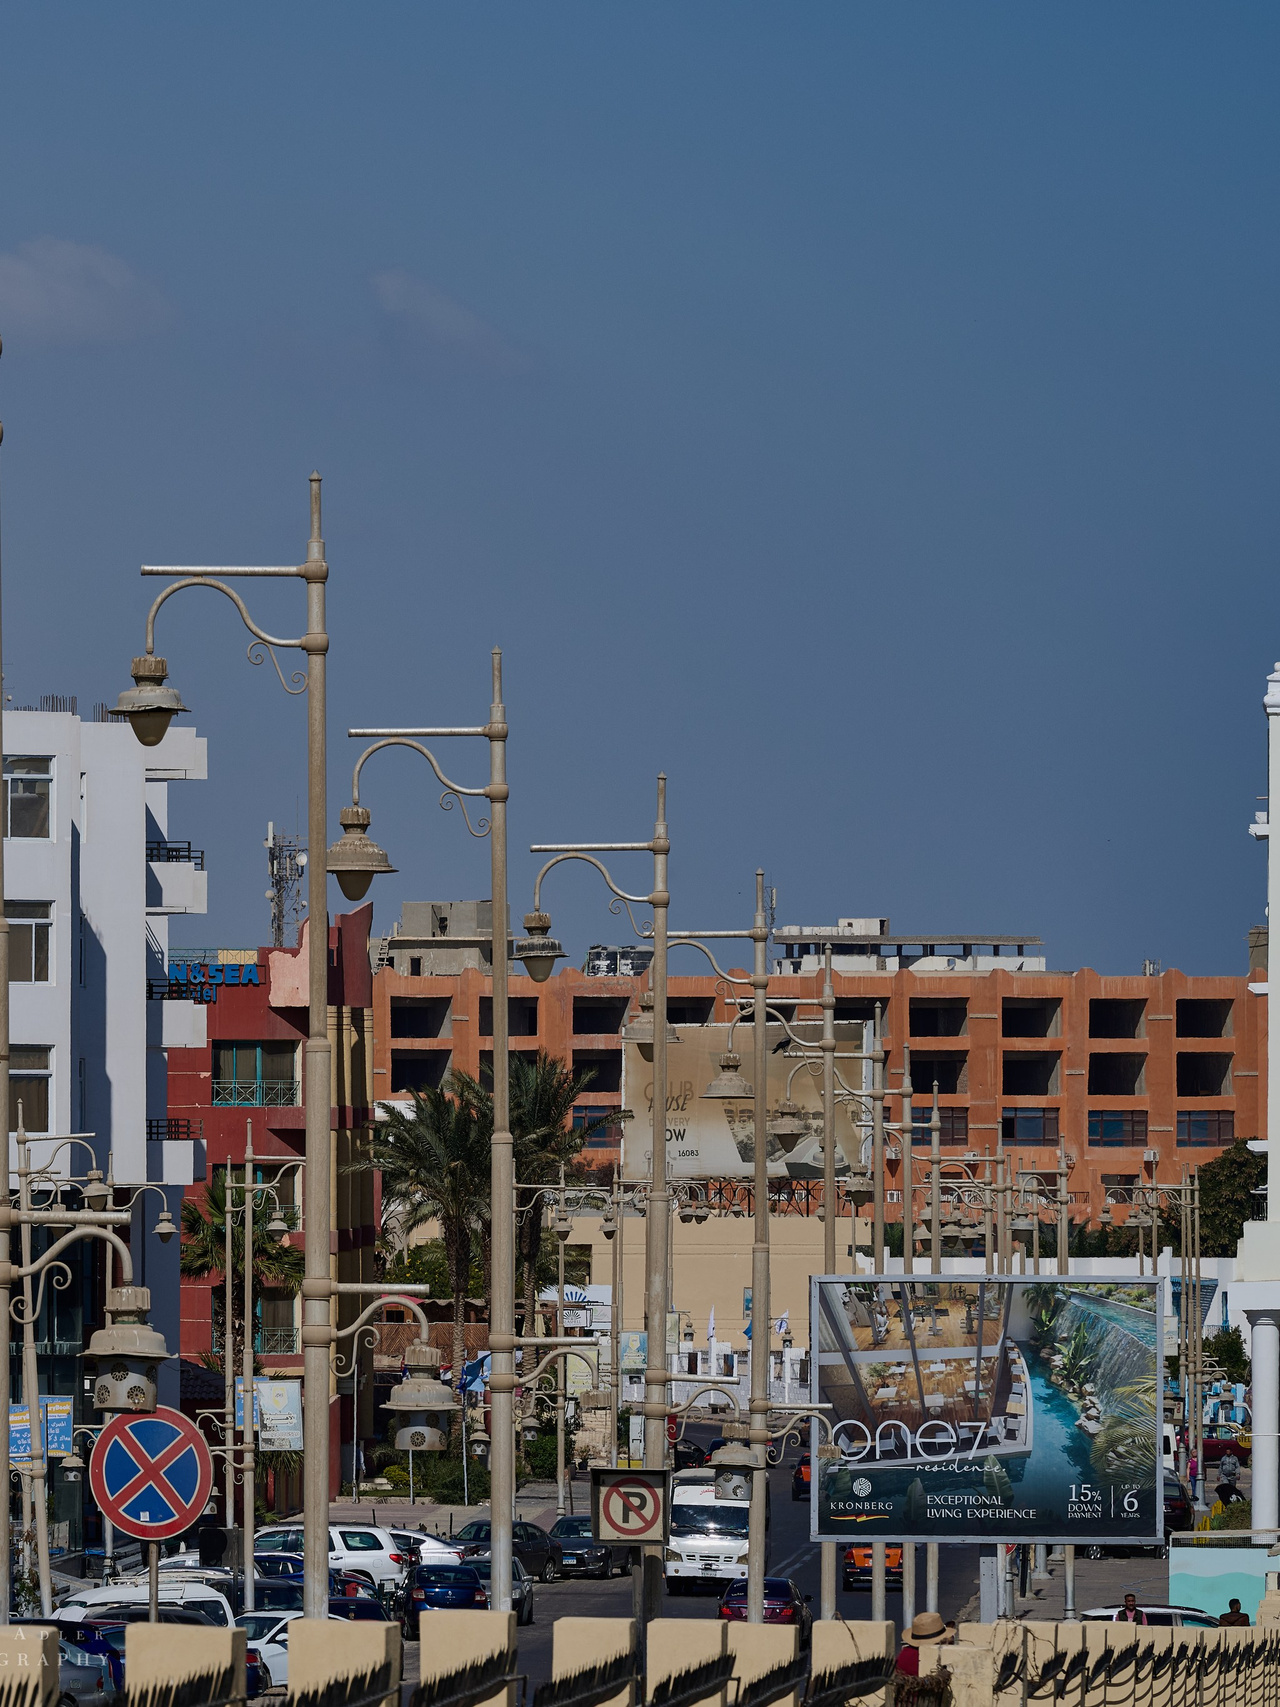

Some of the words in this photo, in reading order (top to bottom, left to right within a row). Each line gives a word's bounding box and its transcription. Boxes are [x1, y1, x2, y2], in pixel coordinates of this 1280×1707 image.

[644, 1080, 694, 1101] CUB
[648, 1094, 690, 1112] USE
[649, 1117, 690, 1127] DVERY
[665, 1128, 686, 1142] OW
[678, 1149, 699, 1157] 16083
[832, 1419, 987, 1462] one7
[1069, 1484, 1102, 1501] 15%
[830, 1501, 893, 1511] KRONBERG
[927, 1495, 1004, 1505] EXCEPTIONAL
[1123, 1490, 1138, 1512] 6
[622, 1491, 647, 1524] P
[927, 1508, 962, 1519] LIVING
[967, 1509, 1037, 1519] EXPERIENCE
[1068, 1503, 1102, 1512] DOWN
